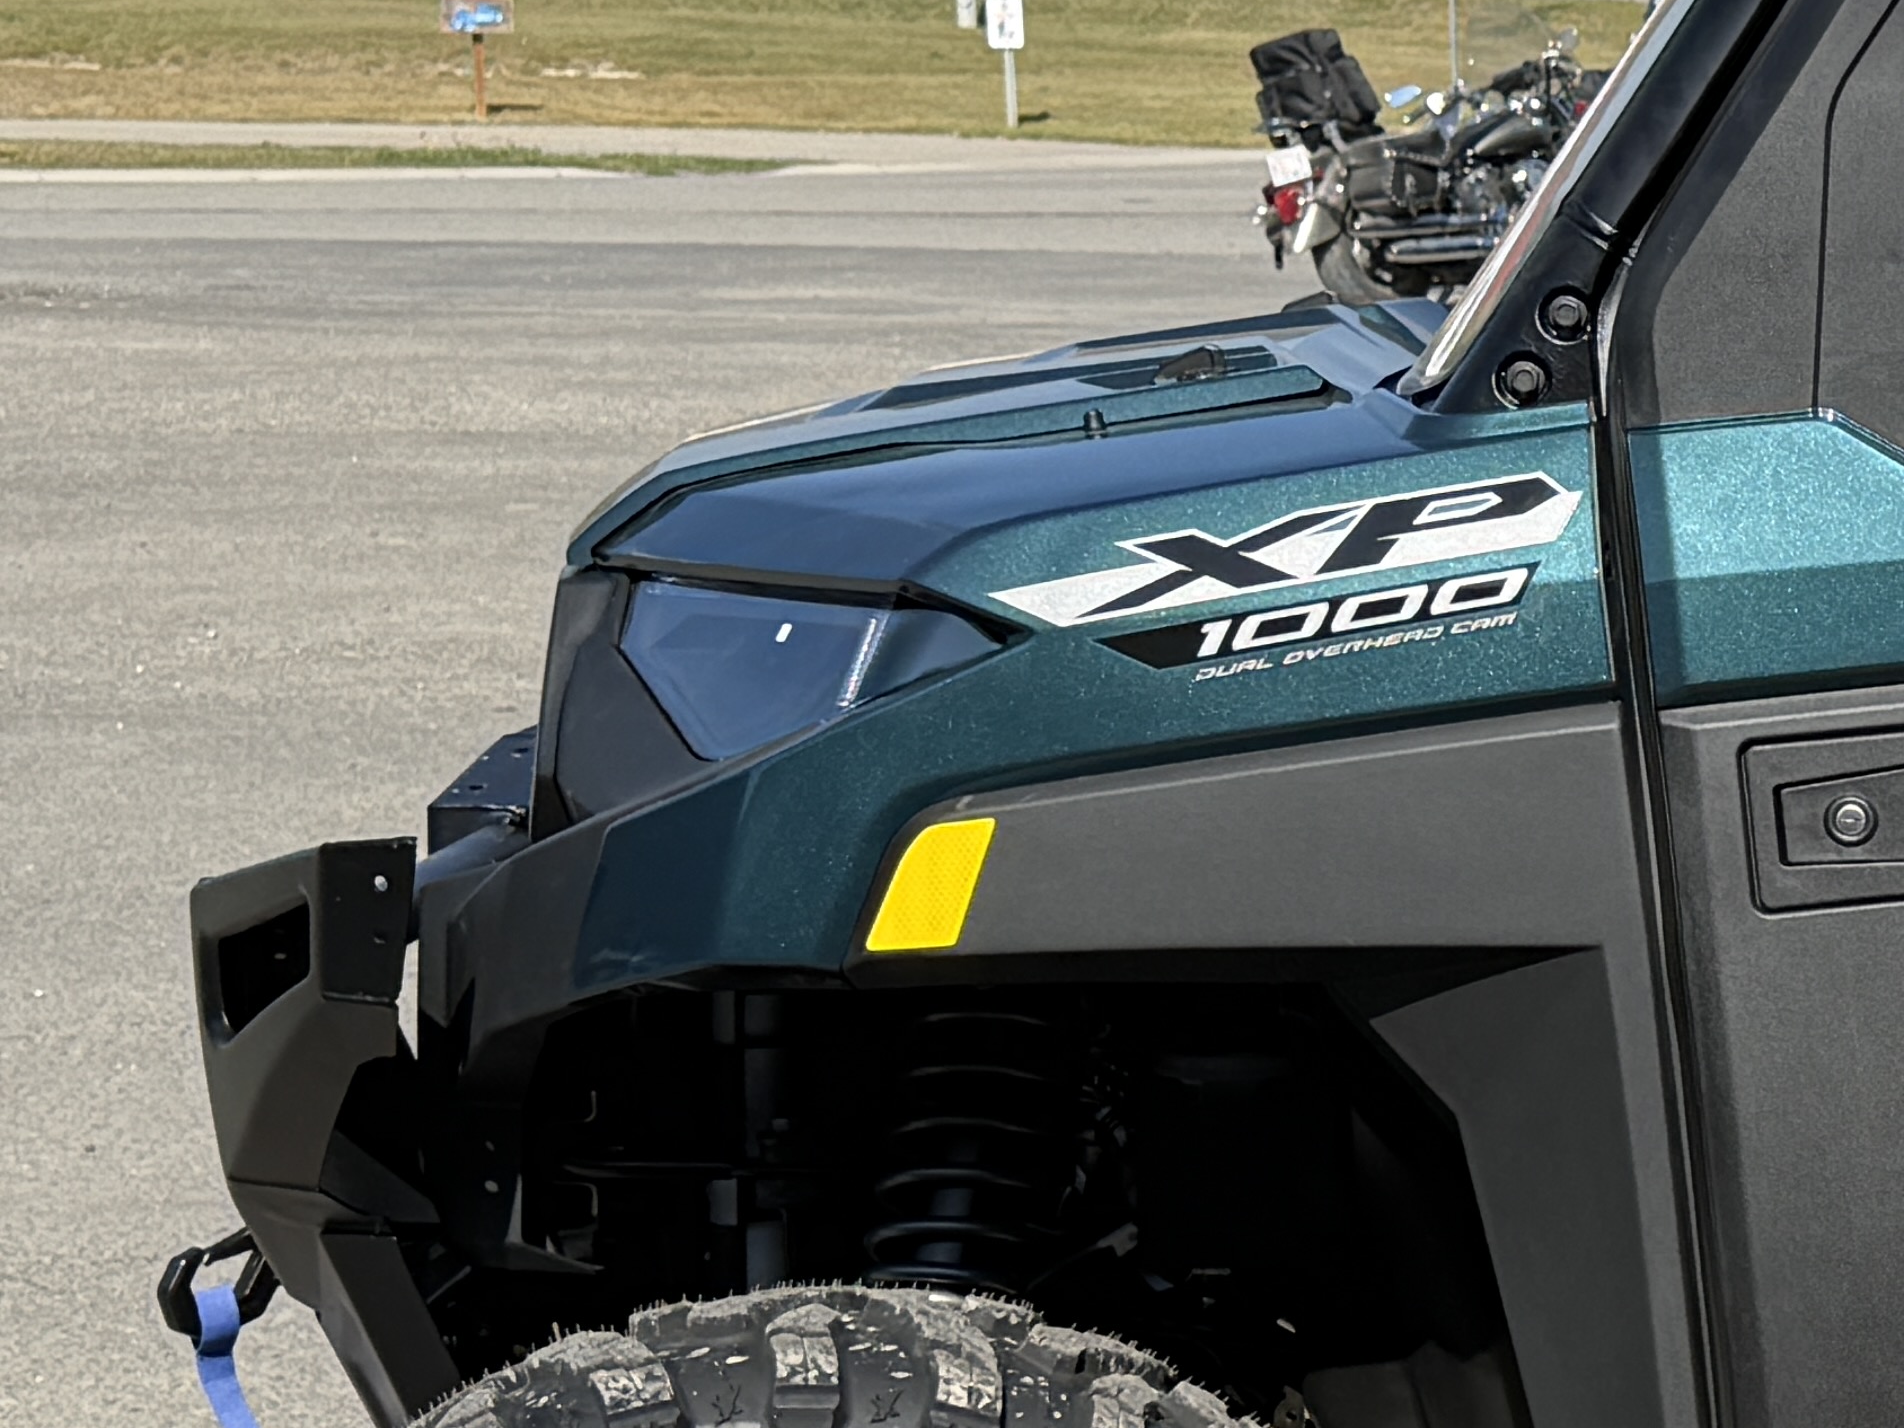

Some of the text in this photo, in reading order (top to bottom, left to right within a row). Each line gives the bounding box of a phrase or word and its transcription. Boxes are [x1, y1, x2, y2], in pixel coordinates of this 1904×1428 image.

[1078, 473, 1566, 619] XP
[1195, 611, 1518, 682] DUAL OVERHEAD CAM
[1197, 568, 1529, 658] 1000
